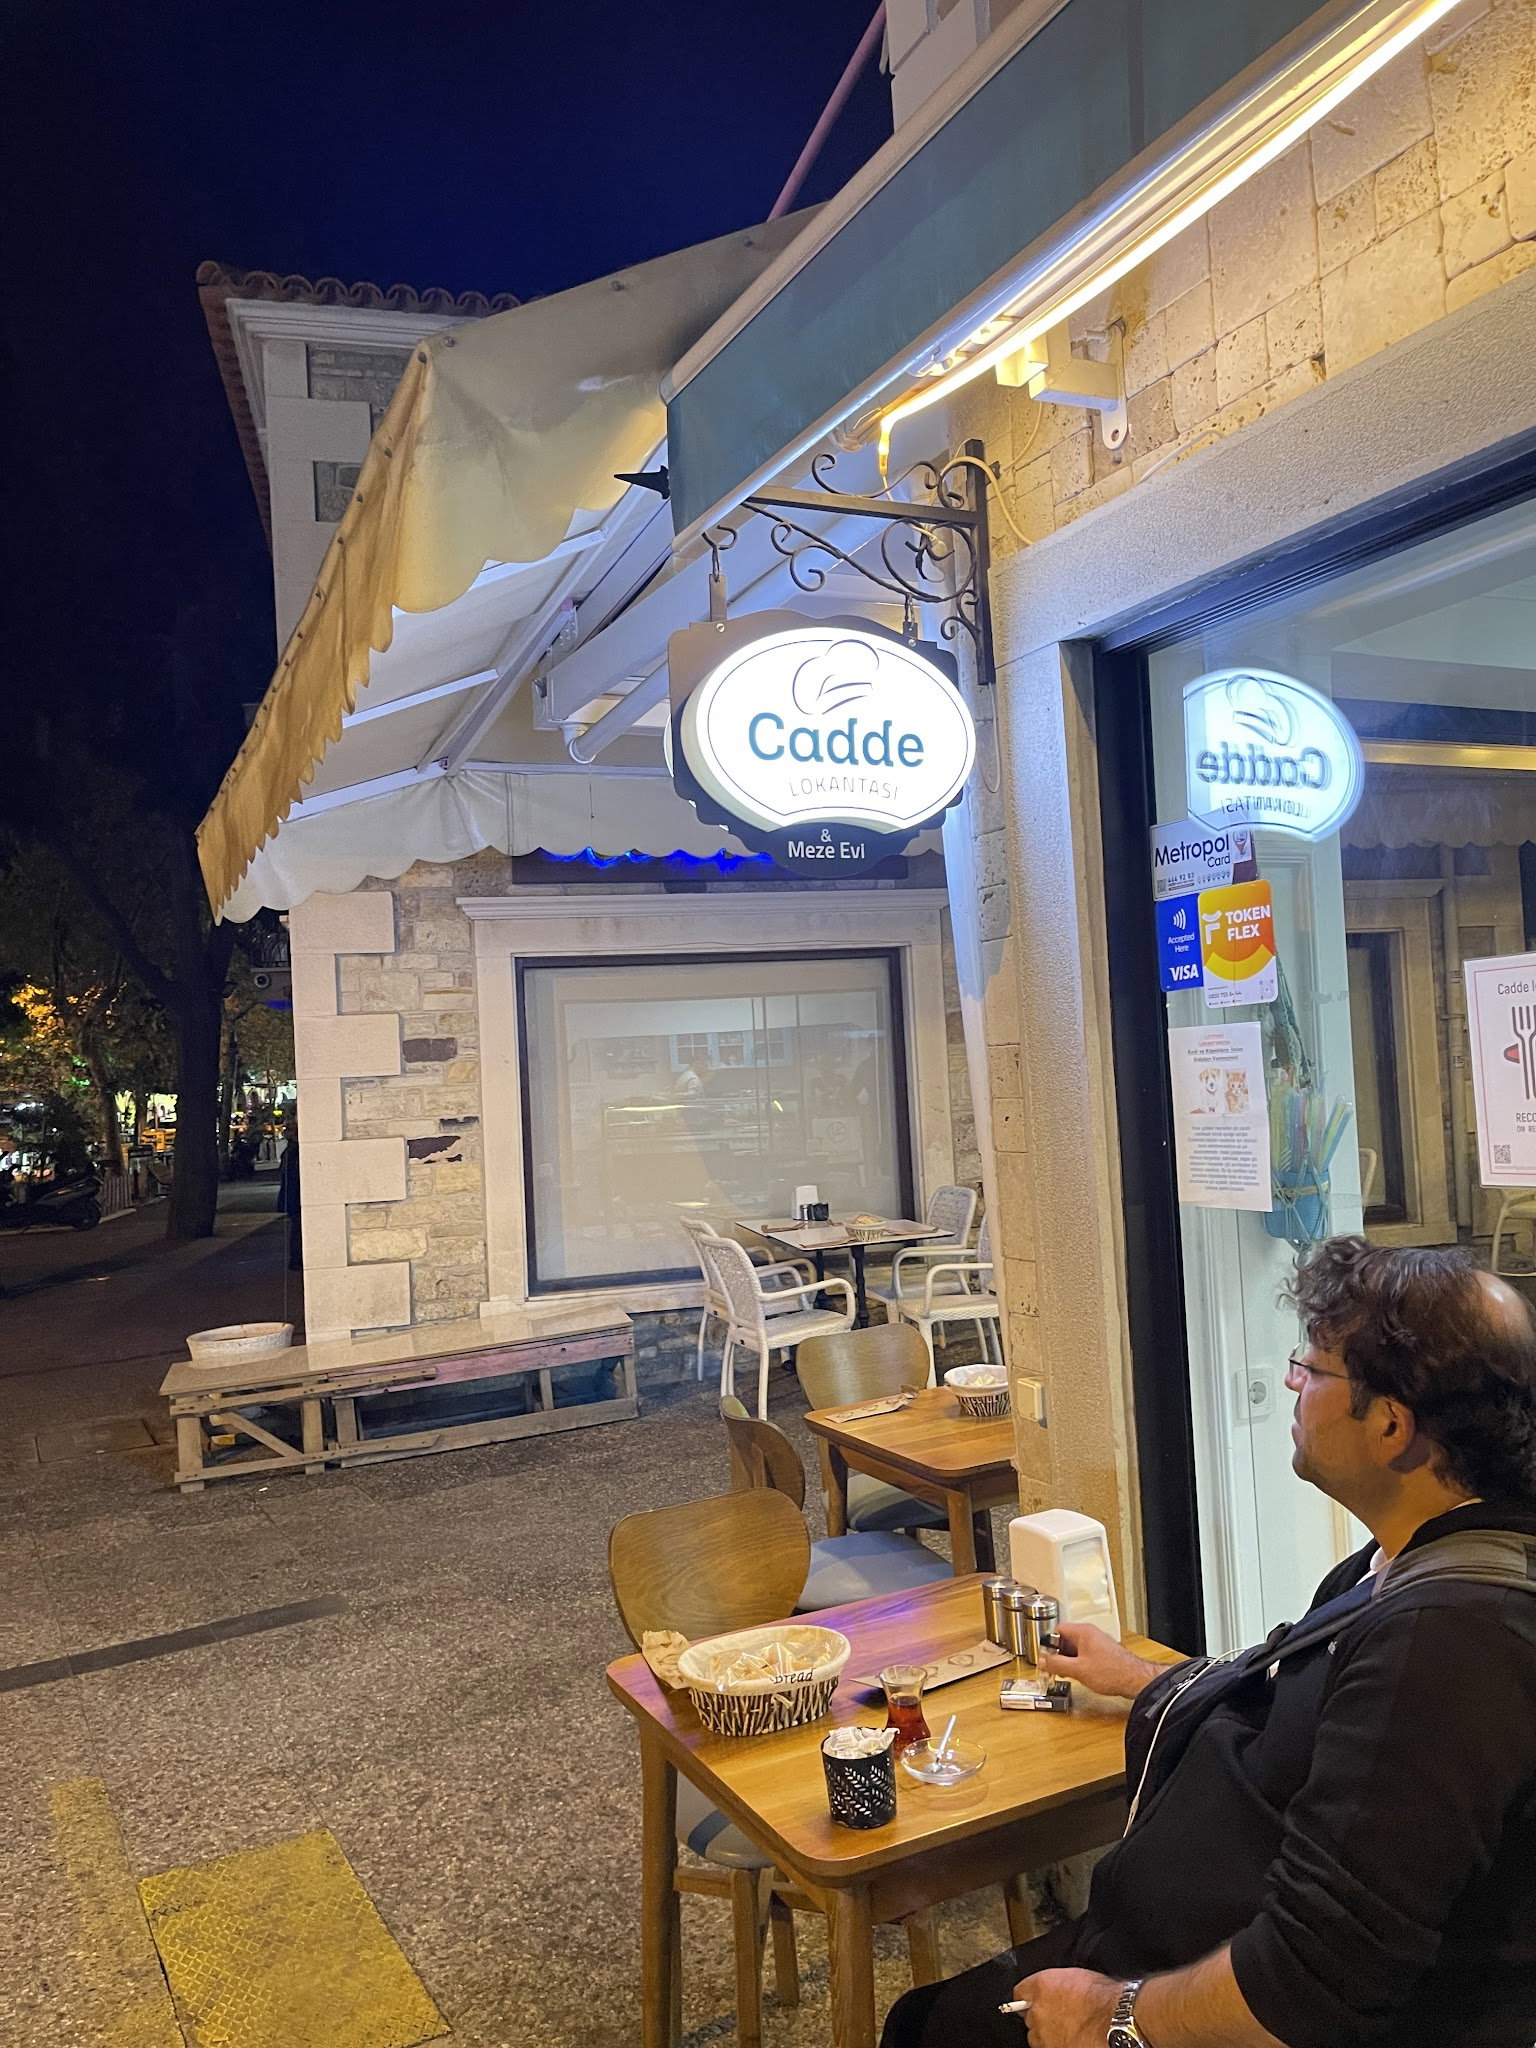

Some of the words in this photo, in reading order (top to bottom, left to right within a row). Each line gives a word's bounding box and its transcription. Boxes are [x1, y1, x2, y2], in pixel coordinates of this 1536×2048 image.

[748, 712, 924, 768] Cadde
[789, 776, 898, 800] LOKANTASI
[821, 829, 832, 842] &
[788, 841, 835, 859] Meze
[840, 842, 865, 859] Evi
[1154, 834, 1230, 867] Metropol
[1207, 853, 1231, 868] Card
[1225, 905, 1271, 925] TOKEN
[1168, 932, 1195, 944] Accepted
[1227, 924, 1260, 941] FLEX
[1174, 945, 1190, 953] Here
[1168, 963, 1199, 981] VISA
[1497, 981, 1529, 995] Cadde
